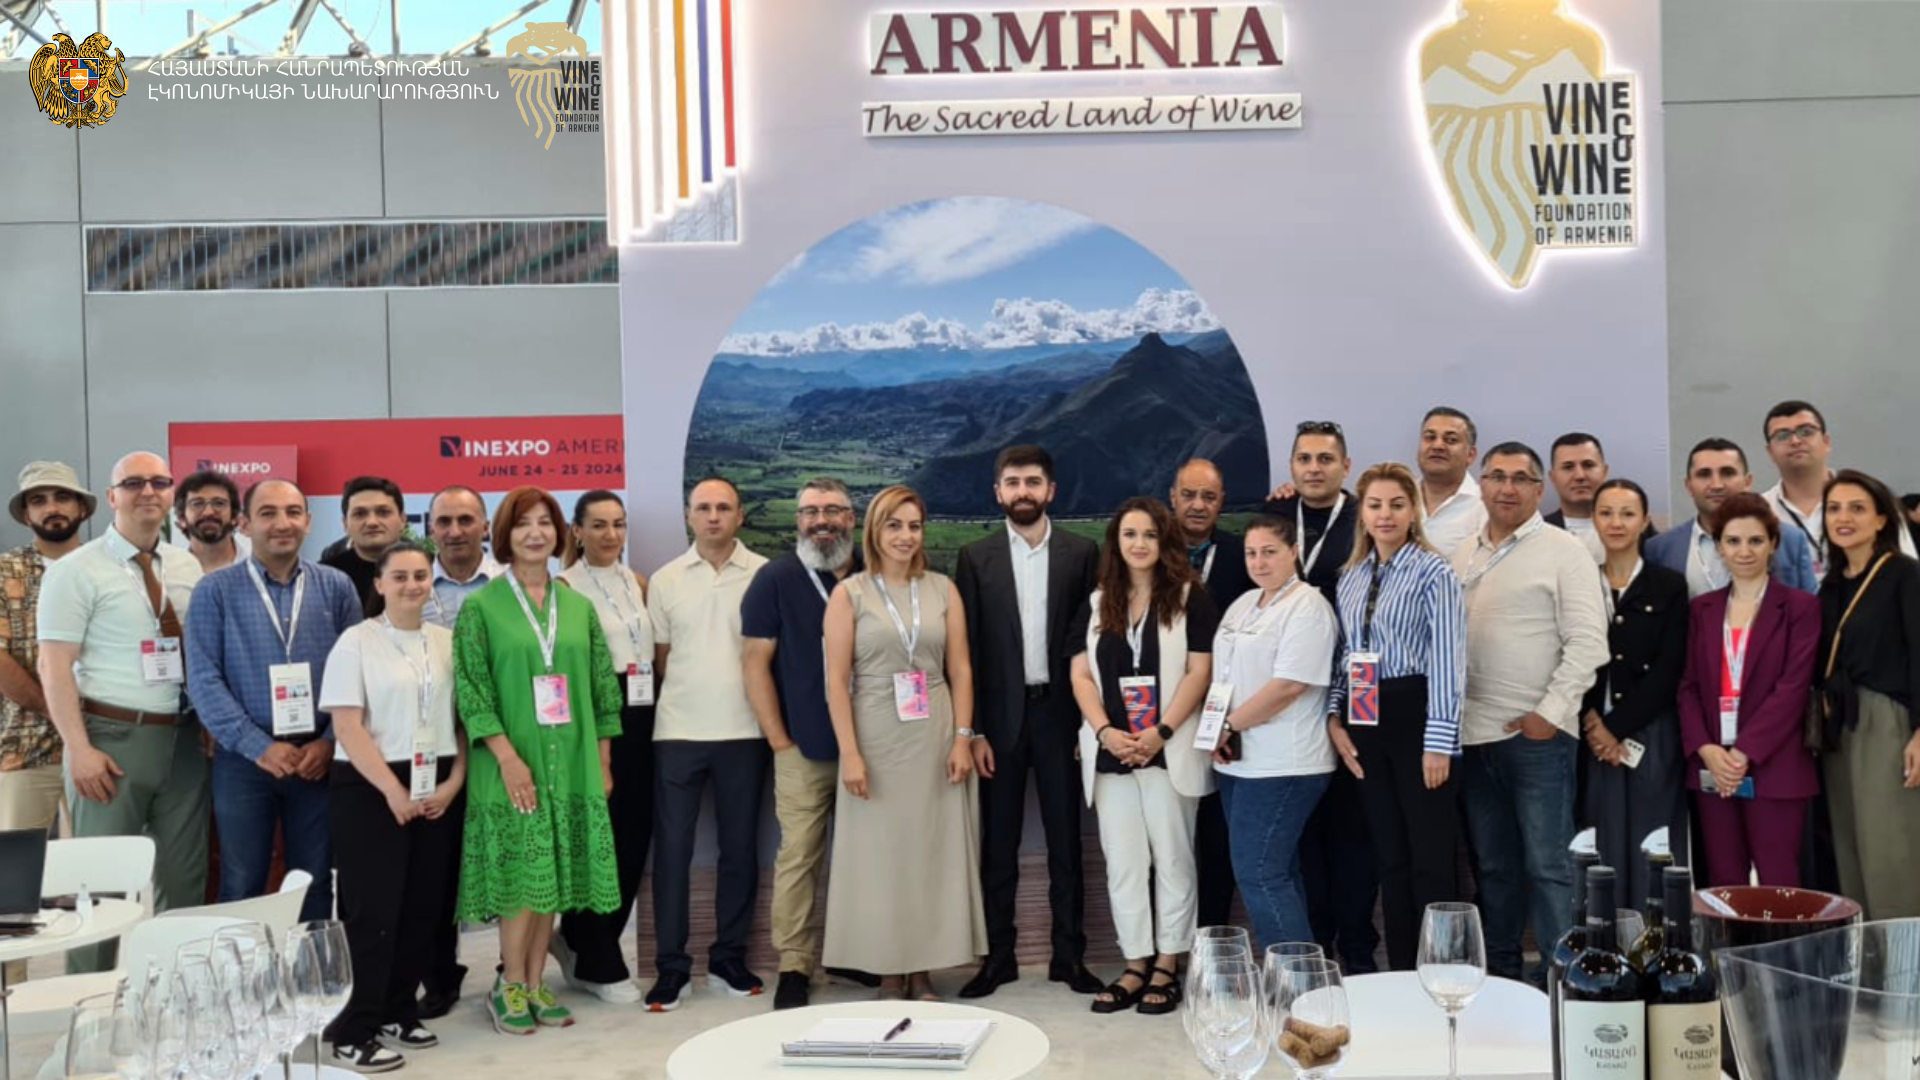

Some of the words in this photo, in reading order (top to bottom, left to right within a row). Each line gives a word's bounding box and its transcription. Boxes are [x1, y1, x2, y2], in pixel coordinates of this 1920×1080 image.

[870, 6, 1284, 75] ARMENIA
[863, 105, 929, 134] The
[933, 101, 1057, 133] Sacred
[1065, 98, 1161, 128] Land
[1168, 95, 1206, 131] of
[1209, 97, 1300, 122] Wine
[1542, 81, 1630, 135] VINE
[1530, 143, 1632, 196] WINE
[1535, 202, 1632, 222] FOUNDATION
[1535, 227, 1553, 245] OF
[1564, 225, 1633, 244] ARMENIA
[478, 465, 518, 477] JUNE
[524, 465, 543, 476] 24
[562, 464, 579, 475] 25
[586, 463, 623, 474] 2024
